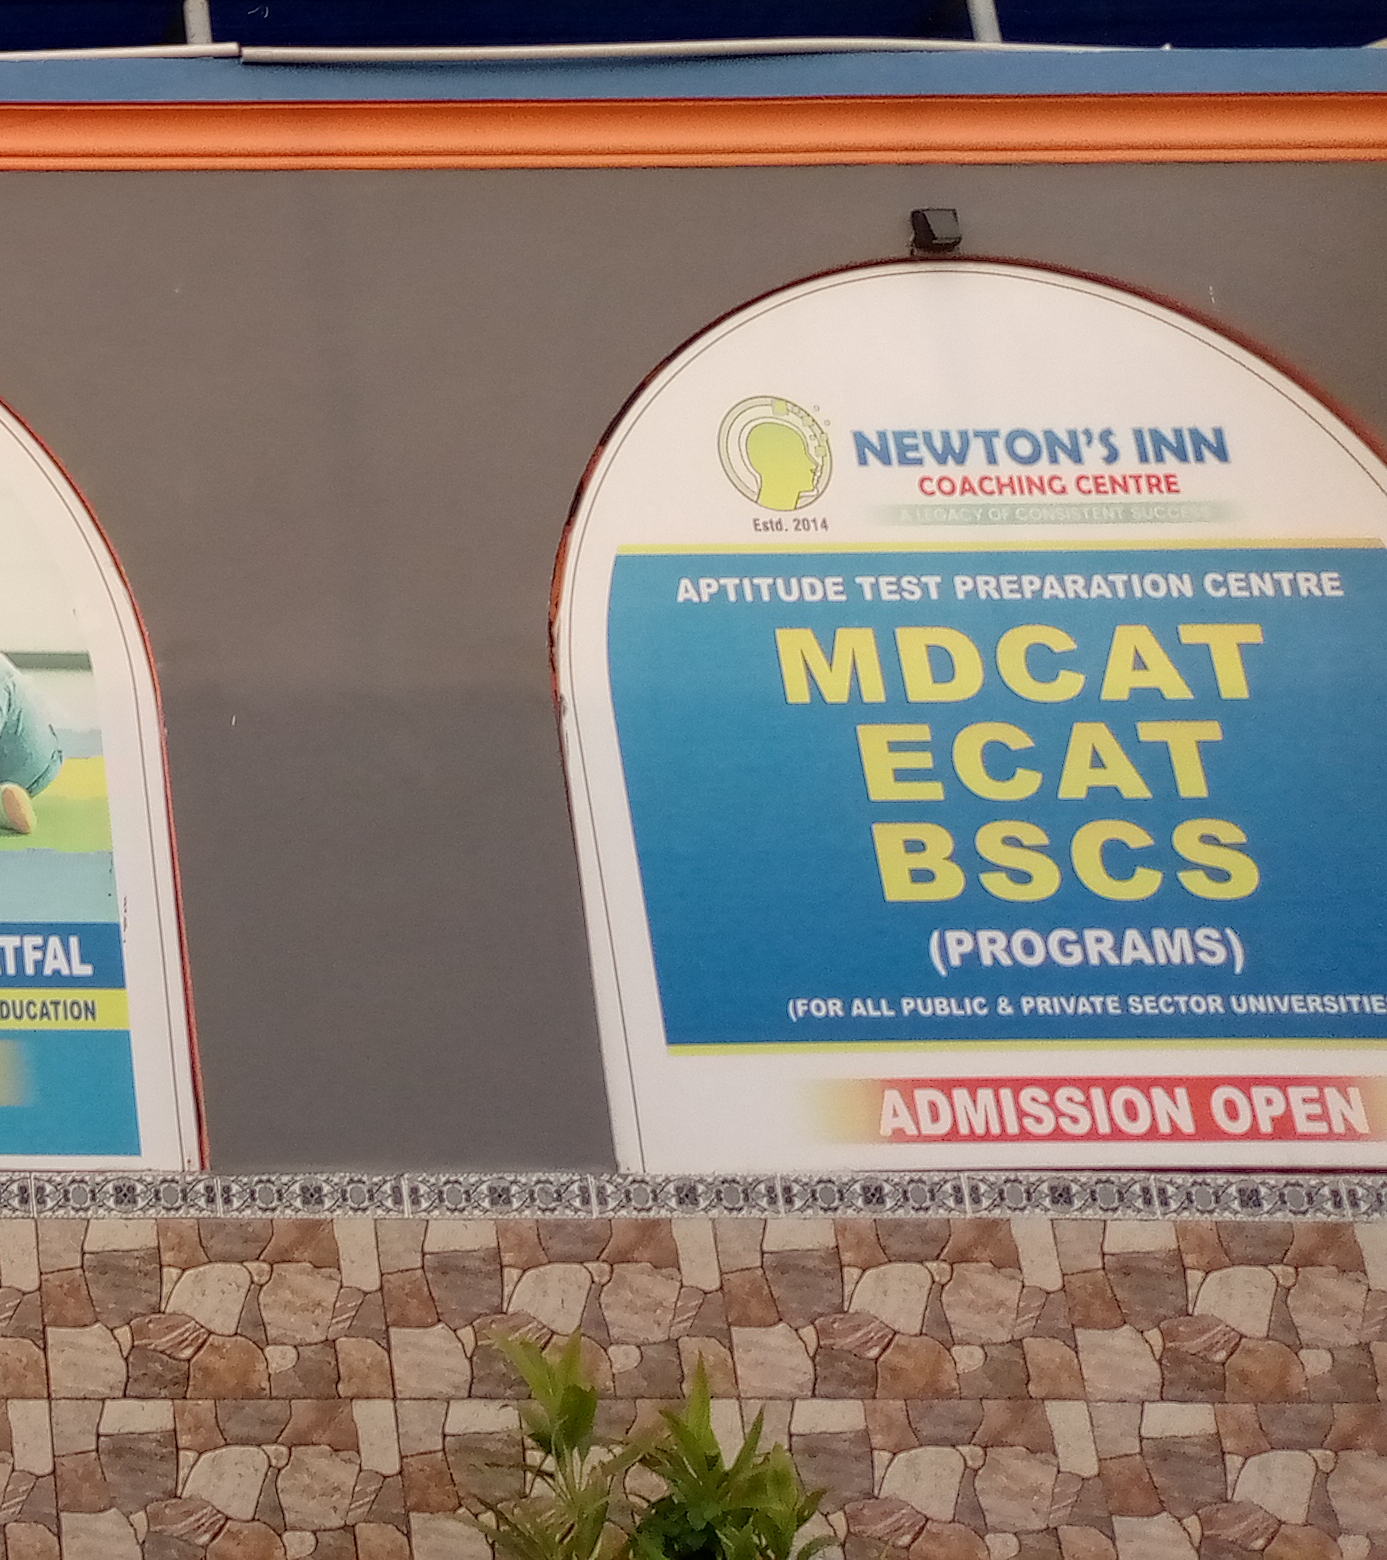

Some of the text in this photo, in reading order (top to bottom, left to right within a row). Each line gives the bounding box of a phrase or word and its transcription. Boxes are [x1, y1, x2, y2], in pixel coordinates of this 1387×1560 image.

[851, 425, 1231, 468] NEWTON'S INN
[918, 472, 1181, 498] COACHING CENTRE
[752, 516, 829, 534] Estd. 2014
[676, 570, 1345, 604] APTITUDE TEST PREPARATION CENTRE
[773, 623, 1265, 705] MDCAT
[855, 719, 1225, 803] ECAT
[870, 818, 1262, 903] BSCS
[929, 927, 1246, 977] (PROGRAMS)
[787, 994, 1387, 1022] (FOR ALL PUBLIC & PRIVATE SECTOR UNIVERSITIE
[879, 1084, 1372, 1138] ADMISSION OPEN
